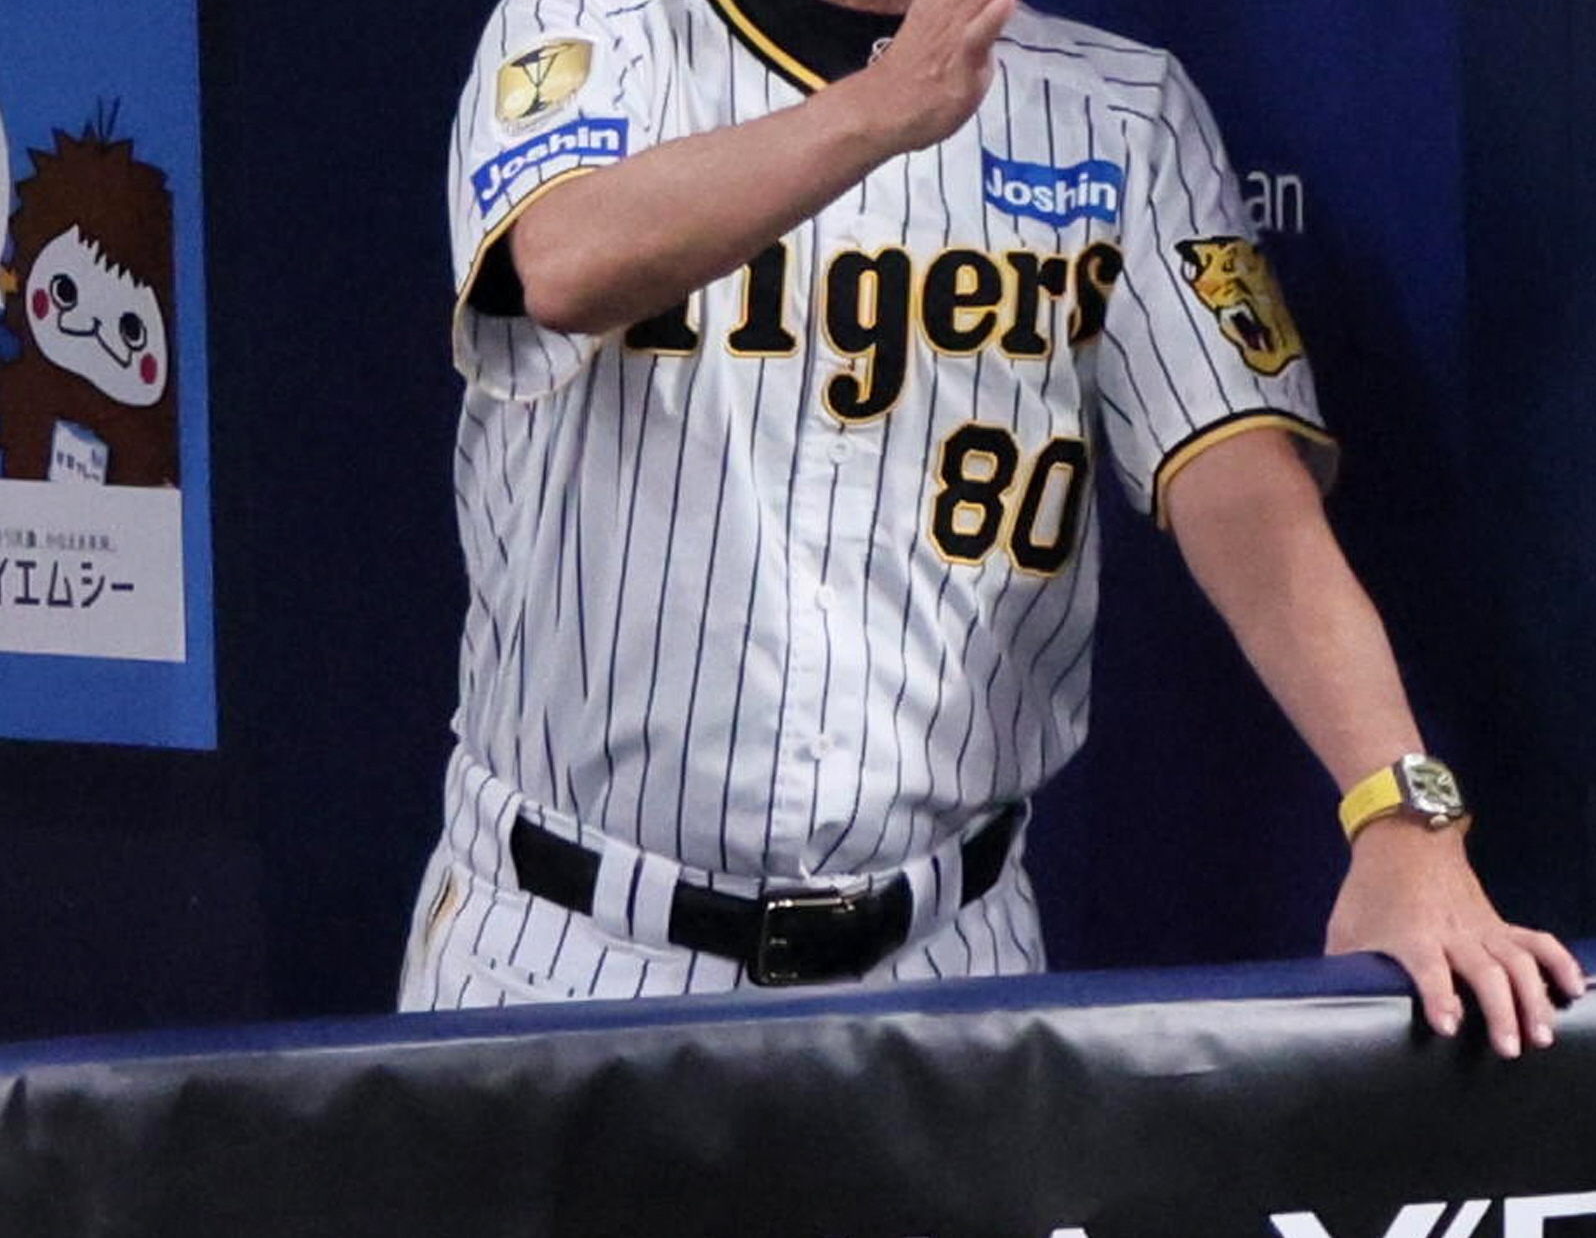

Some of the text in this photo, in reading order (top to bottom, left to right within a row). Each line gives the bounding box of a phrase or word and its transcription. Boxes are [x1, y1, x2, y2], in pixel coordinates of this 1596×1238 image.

[481, 125, 620, 202] Joshin
[984, 167, 1118, 212] Joshin
[622, 240, 1124, 424] igers
[930, 418, 1090, 578] 80
